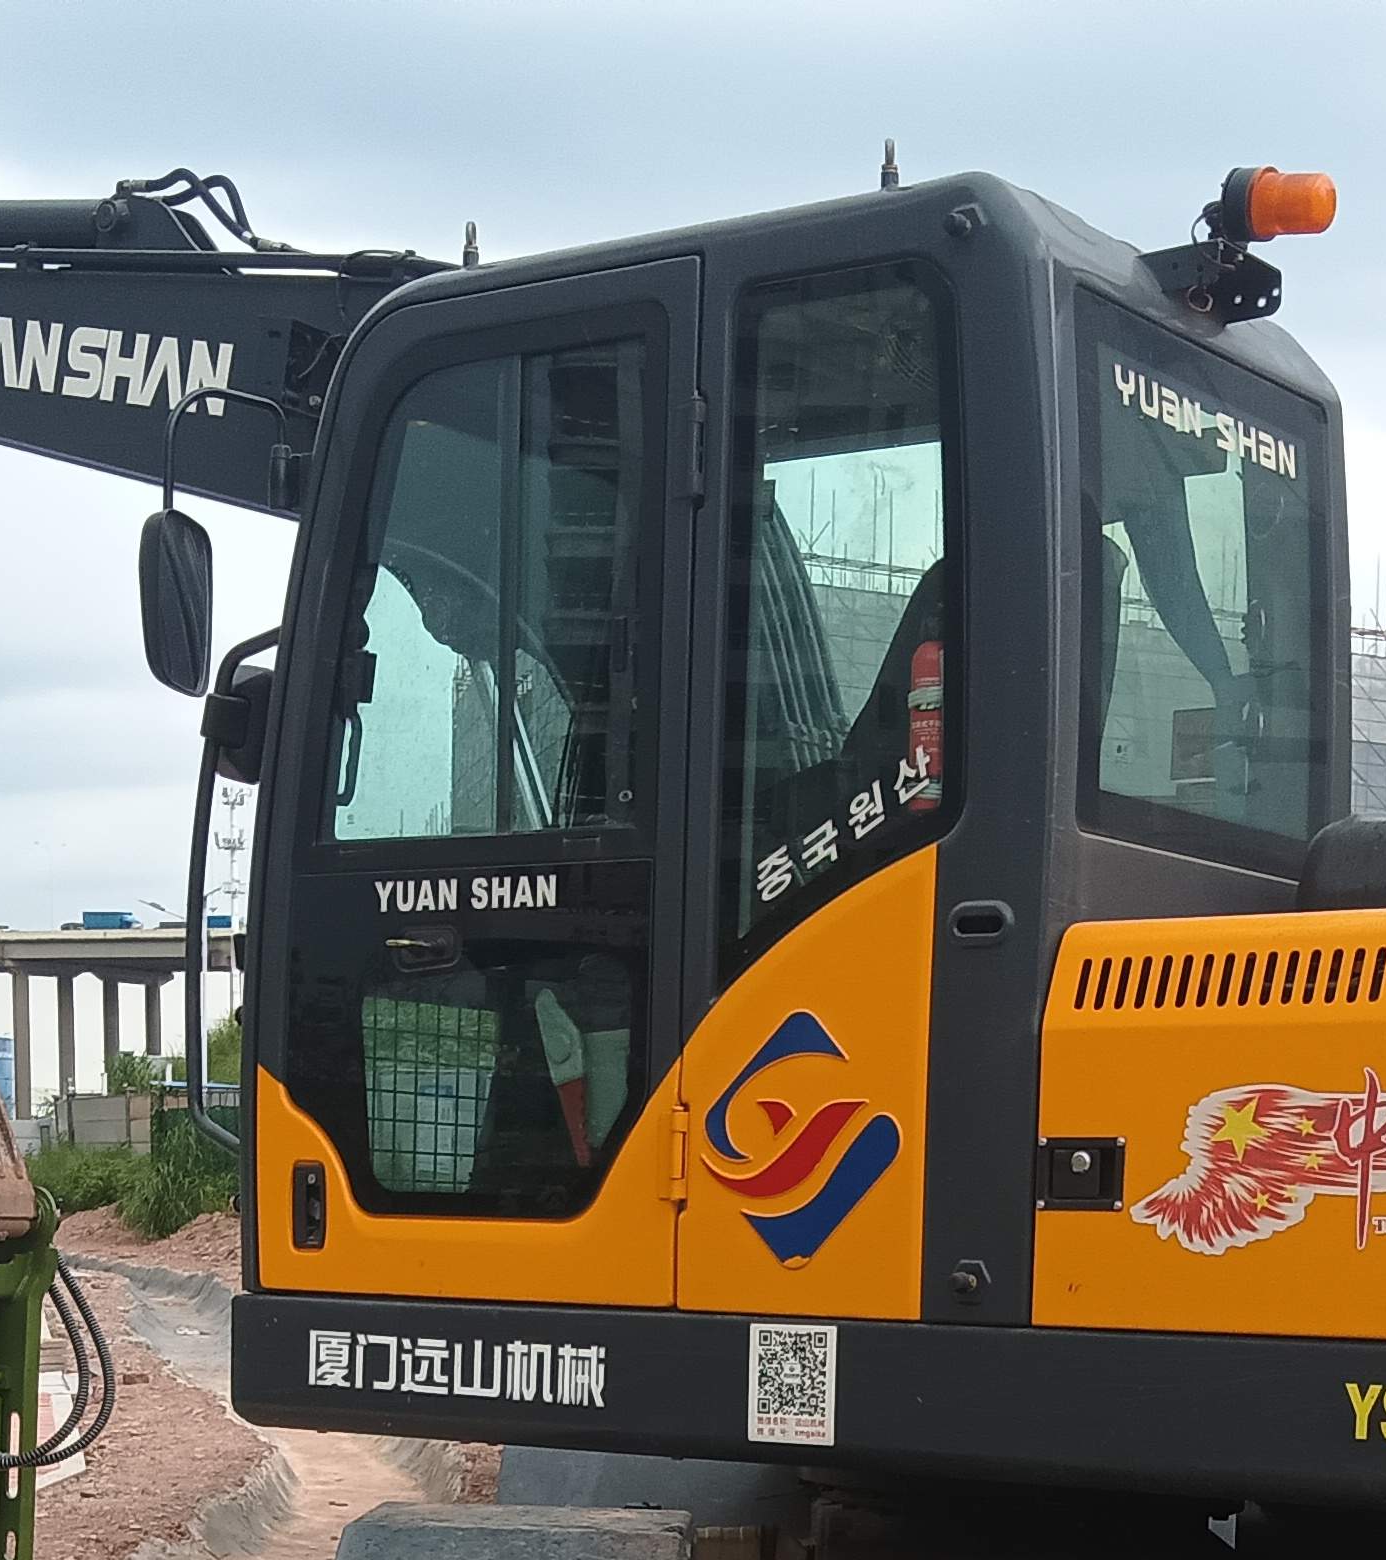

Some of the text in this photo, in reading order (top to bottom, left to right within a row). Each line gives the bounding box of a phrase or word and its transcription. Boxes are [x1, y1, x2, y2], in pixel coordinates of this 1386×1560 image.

[374, 874, 558, 913] YUAN SHAN
[307, 1329, 606, 1408] 厦门远山机械
